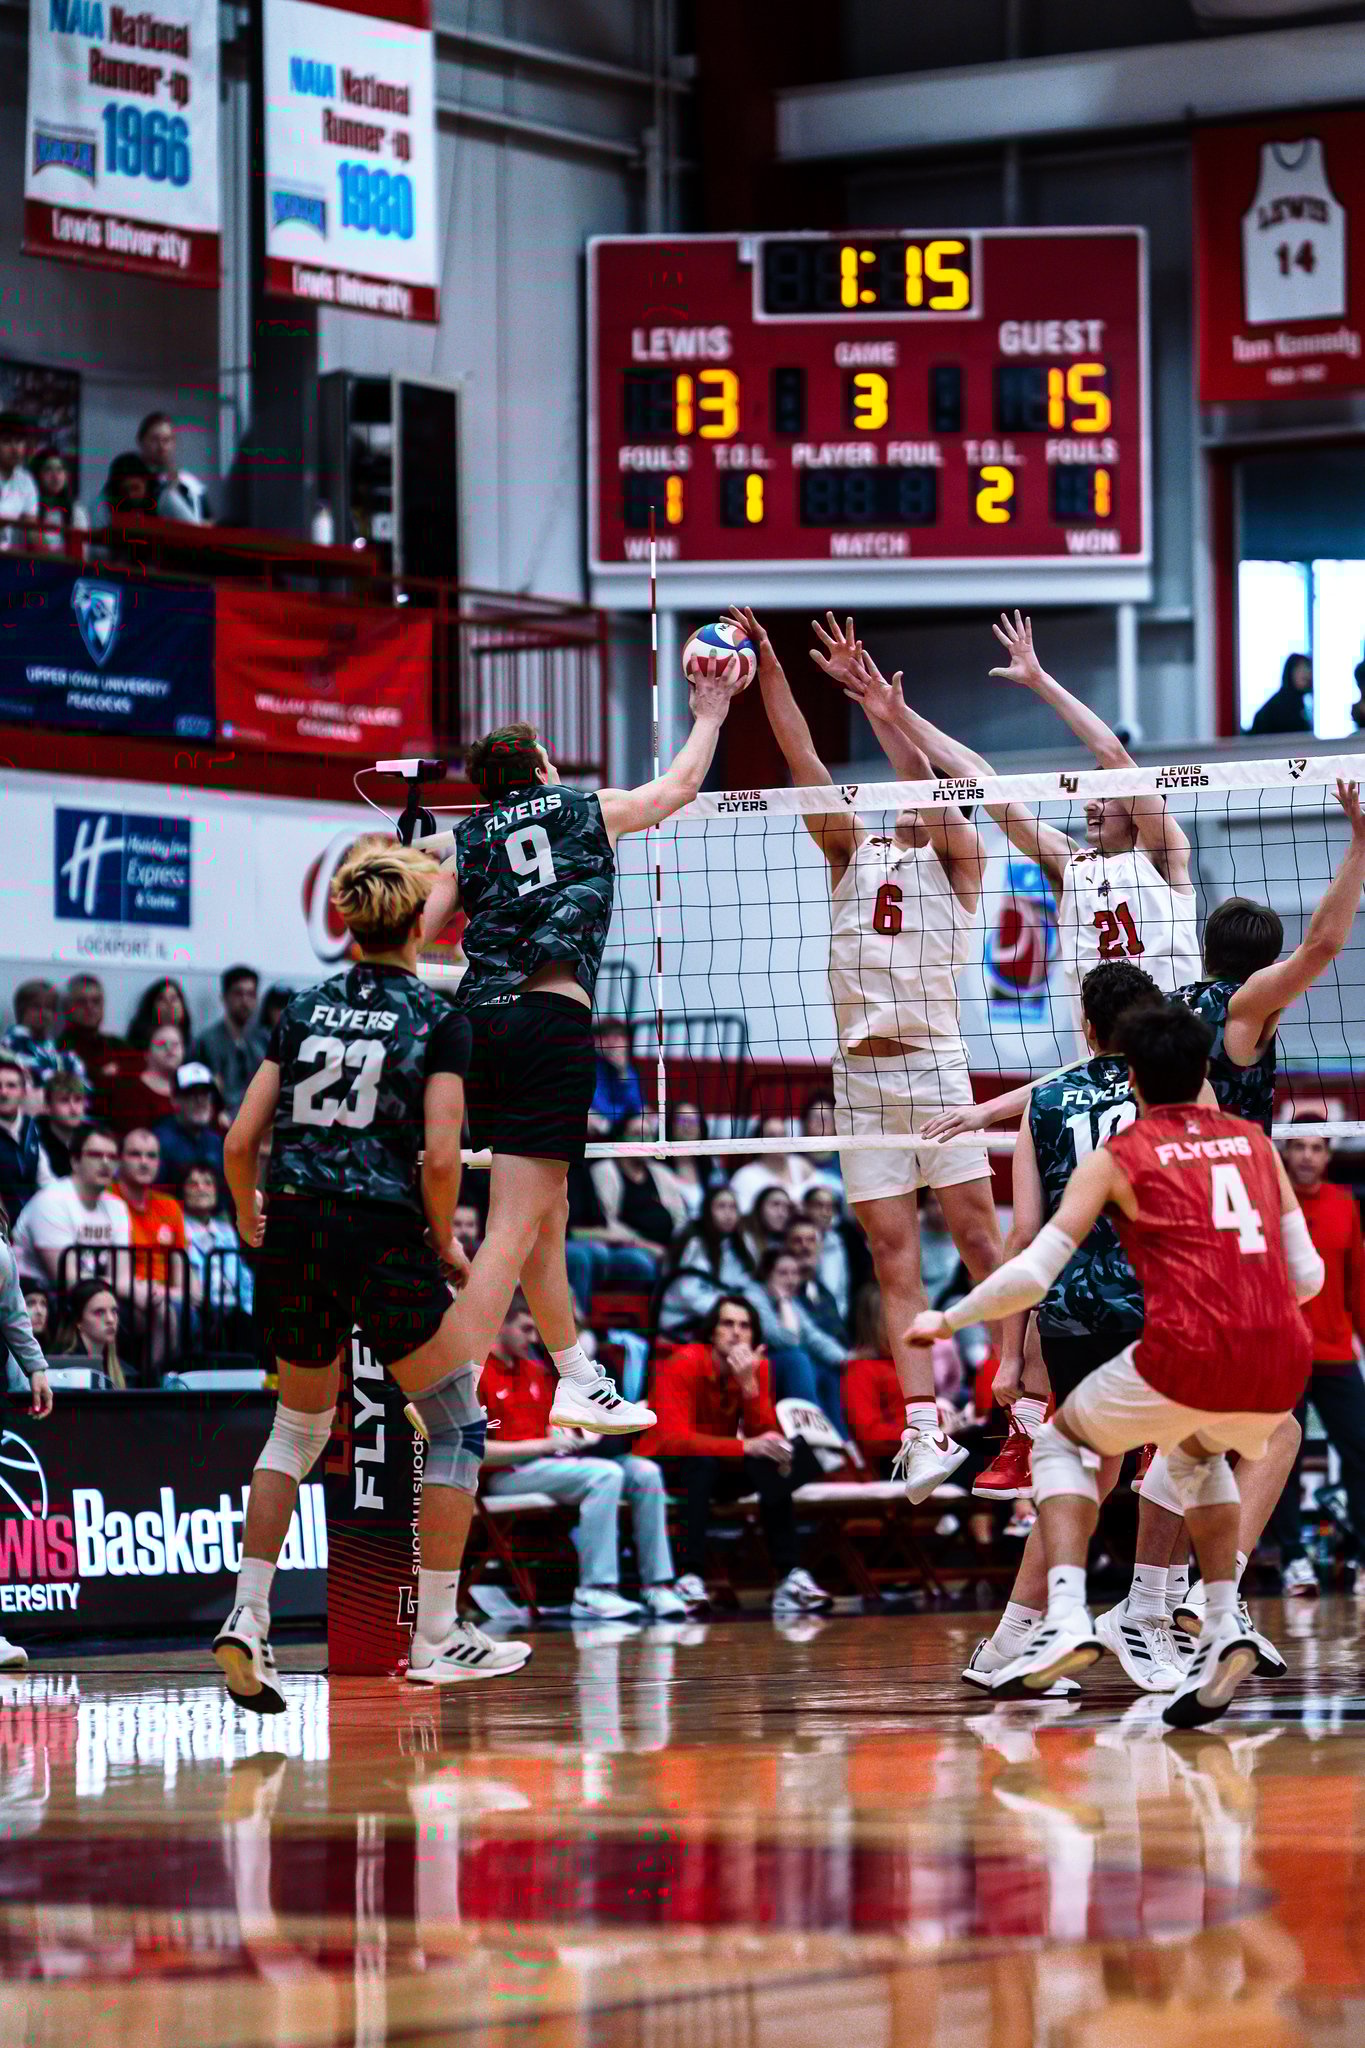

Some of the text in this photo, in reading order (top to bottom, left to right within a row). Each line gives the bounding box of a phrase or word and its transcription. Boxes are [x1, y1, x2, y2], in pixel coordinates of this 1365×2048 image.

[110, 5, 189, 59] National
[289, 56, 410, 116] NAIA National
[101, 102, 191, 187] 1966
[338, 161, 413, 240] 1980
[1257, 197, 1329, 231] LEWIS
[52, 208, 191, 269] Lewis University
[841, 240, 969, 311] 1:15
[1275, 240, 1316, 275] 14
[292, 264, 412, 320] Lewis University
[631, 325, 732, 361] LEWIS
[834, 340, 897, 368] GAME
[998, 319, 1106, 356] GUEST
[676, 369, 740, 438] 13
[853, 373, 889, 431] 3
[1048, 362, 1111, 433] 15
[618, 444, 693, 471] FOULS
[791, 440, 945, 468] PLAYER FOUL
[1044, 438, 1120, 465] FOULS
[666, 475, 684, 524] 1
[746, 473, 764, 523] 1
[976, 466, 1015, 523] 2
[1094, 468, 1111, 517] 1
[830, 532, 911, 559] MATCH
[1064, 528, 1121, 554] WON
[26, 665, 171, 697] UPPER IOWA UNIVERSITY
[66, 691, 133, 714] PEACOCKS
[938, 778, 978, 790] LEWIS
[1155, 775, 1209, 789] FLYERS
[1161, 765, 1203, 776] LEWIS
[717, 799, 768, 813] FLYERS
[723, 790, 762, 801] LEWIS
[933, 788, 985, 802] FLYERS
[484, 793, 562, 839] FLYERS
[127, 833, 188, 860] Holiday Inn
[504, 824, 559, 897] 9
[127, 856, 187, 889] Express
[145, 893, 178, 912] Suites
[873, 883, 903, 937] 6
[1093, 901, 1146, 958] 21
[310, 1004, 399, 1032] FLYERS
[292, 1034, 388, 1130] 23
[1061, 1080, 1134, 1107] FLYER
[1155, 1135, 1253, 1168] FLYERS
[1211, 1163, 1268, 1255] 4
[351, 1322, 386, 1511] FLYE
[412, 1429, 425, 1493] sports
[72, 1483, 328, 1578] Basketall
[0, 1582, 80, 1613] ERSITY
